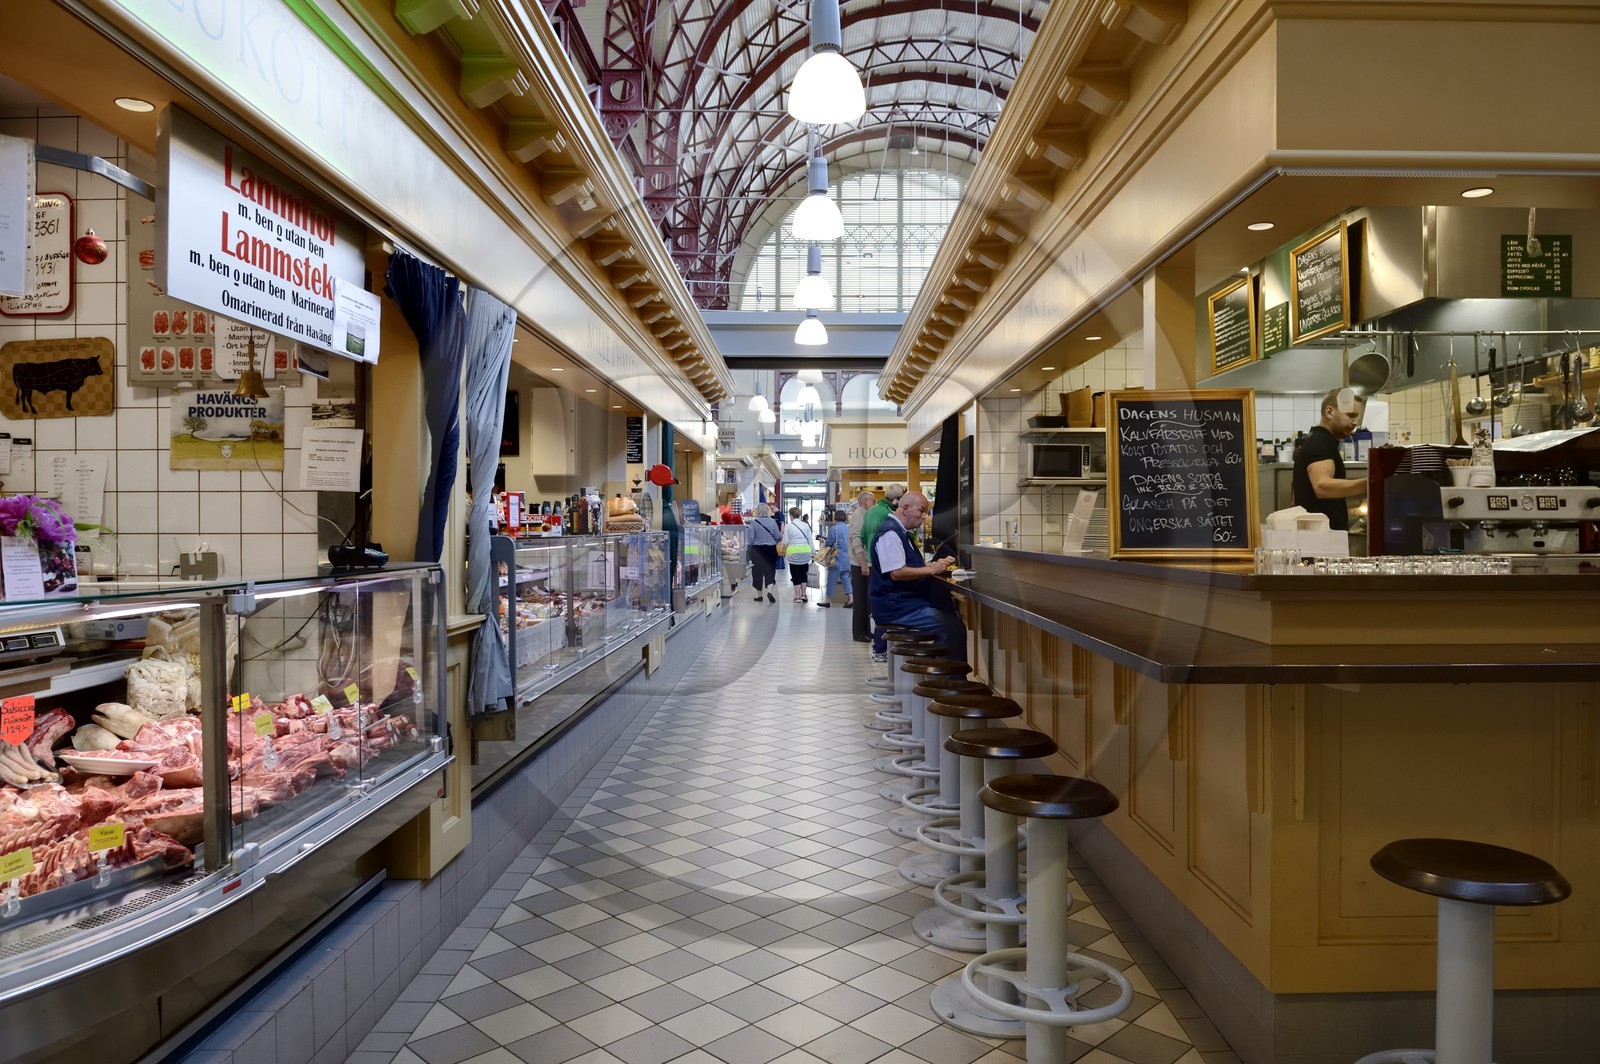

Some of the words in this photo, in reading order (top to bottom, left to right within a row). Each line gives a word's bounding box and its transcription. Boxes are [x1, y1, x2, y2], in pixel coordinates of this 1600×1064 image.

[238, 203, 252, 221] m.
[255, 208, 274, 232] ben
[285, 228, 306, 251] utan
[308, 238, 325, 259] ben
[221, 210, 334, 301] Lammstek
[190, 249, 205, 269] m.
[209, 254, 230, 278] ben
[242, 272, 266, 293] utan
[268, 282, 286, 301] ben
[291, 290, 335, 321] Marinerad
[221, 289, 284, 328] Omarinerad
[286, 315, 304, 335] från
[188, 407, 267, 418] PRODUKTER
[1120, 408, 1177, 420] DAGENS
[1184, 409, 1241, 422] HUSMAN
[848, 446, 897, 459] HUGO
[1129, 474, 1184, 486] DAGENS
[1188, 473, 1222, 484] SOPPA
[1204, 498, 1232, 507] DET
[1129, 517, 1192, 533] UNGERSKA
